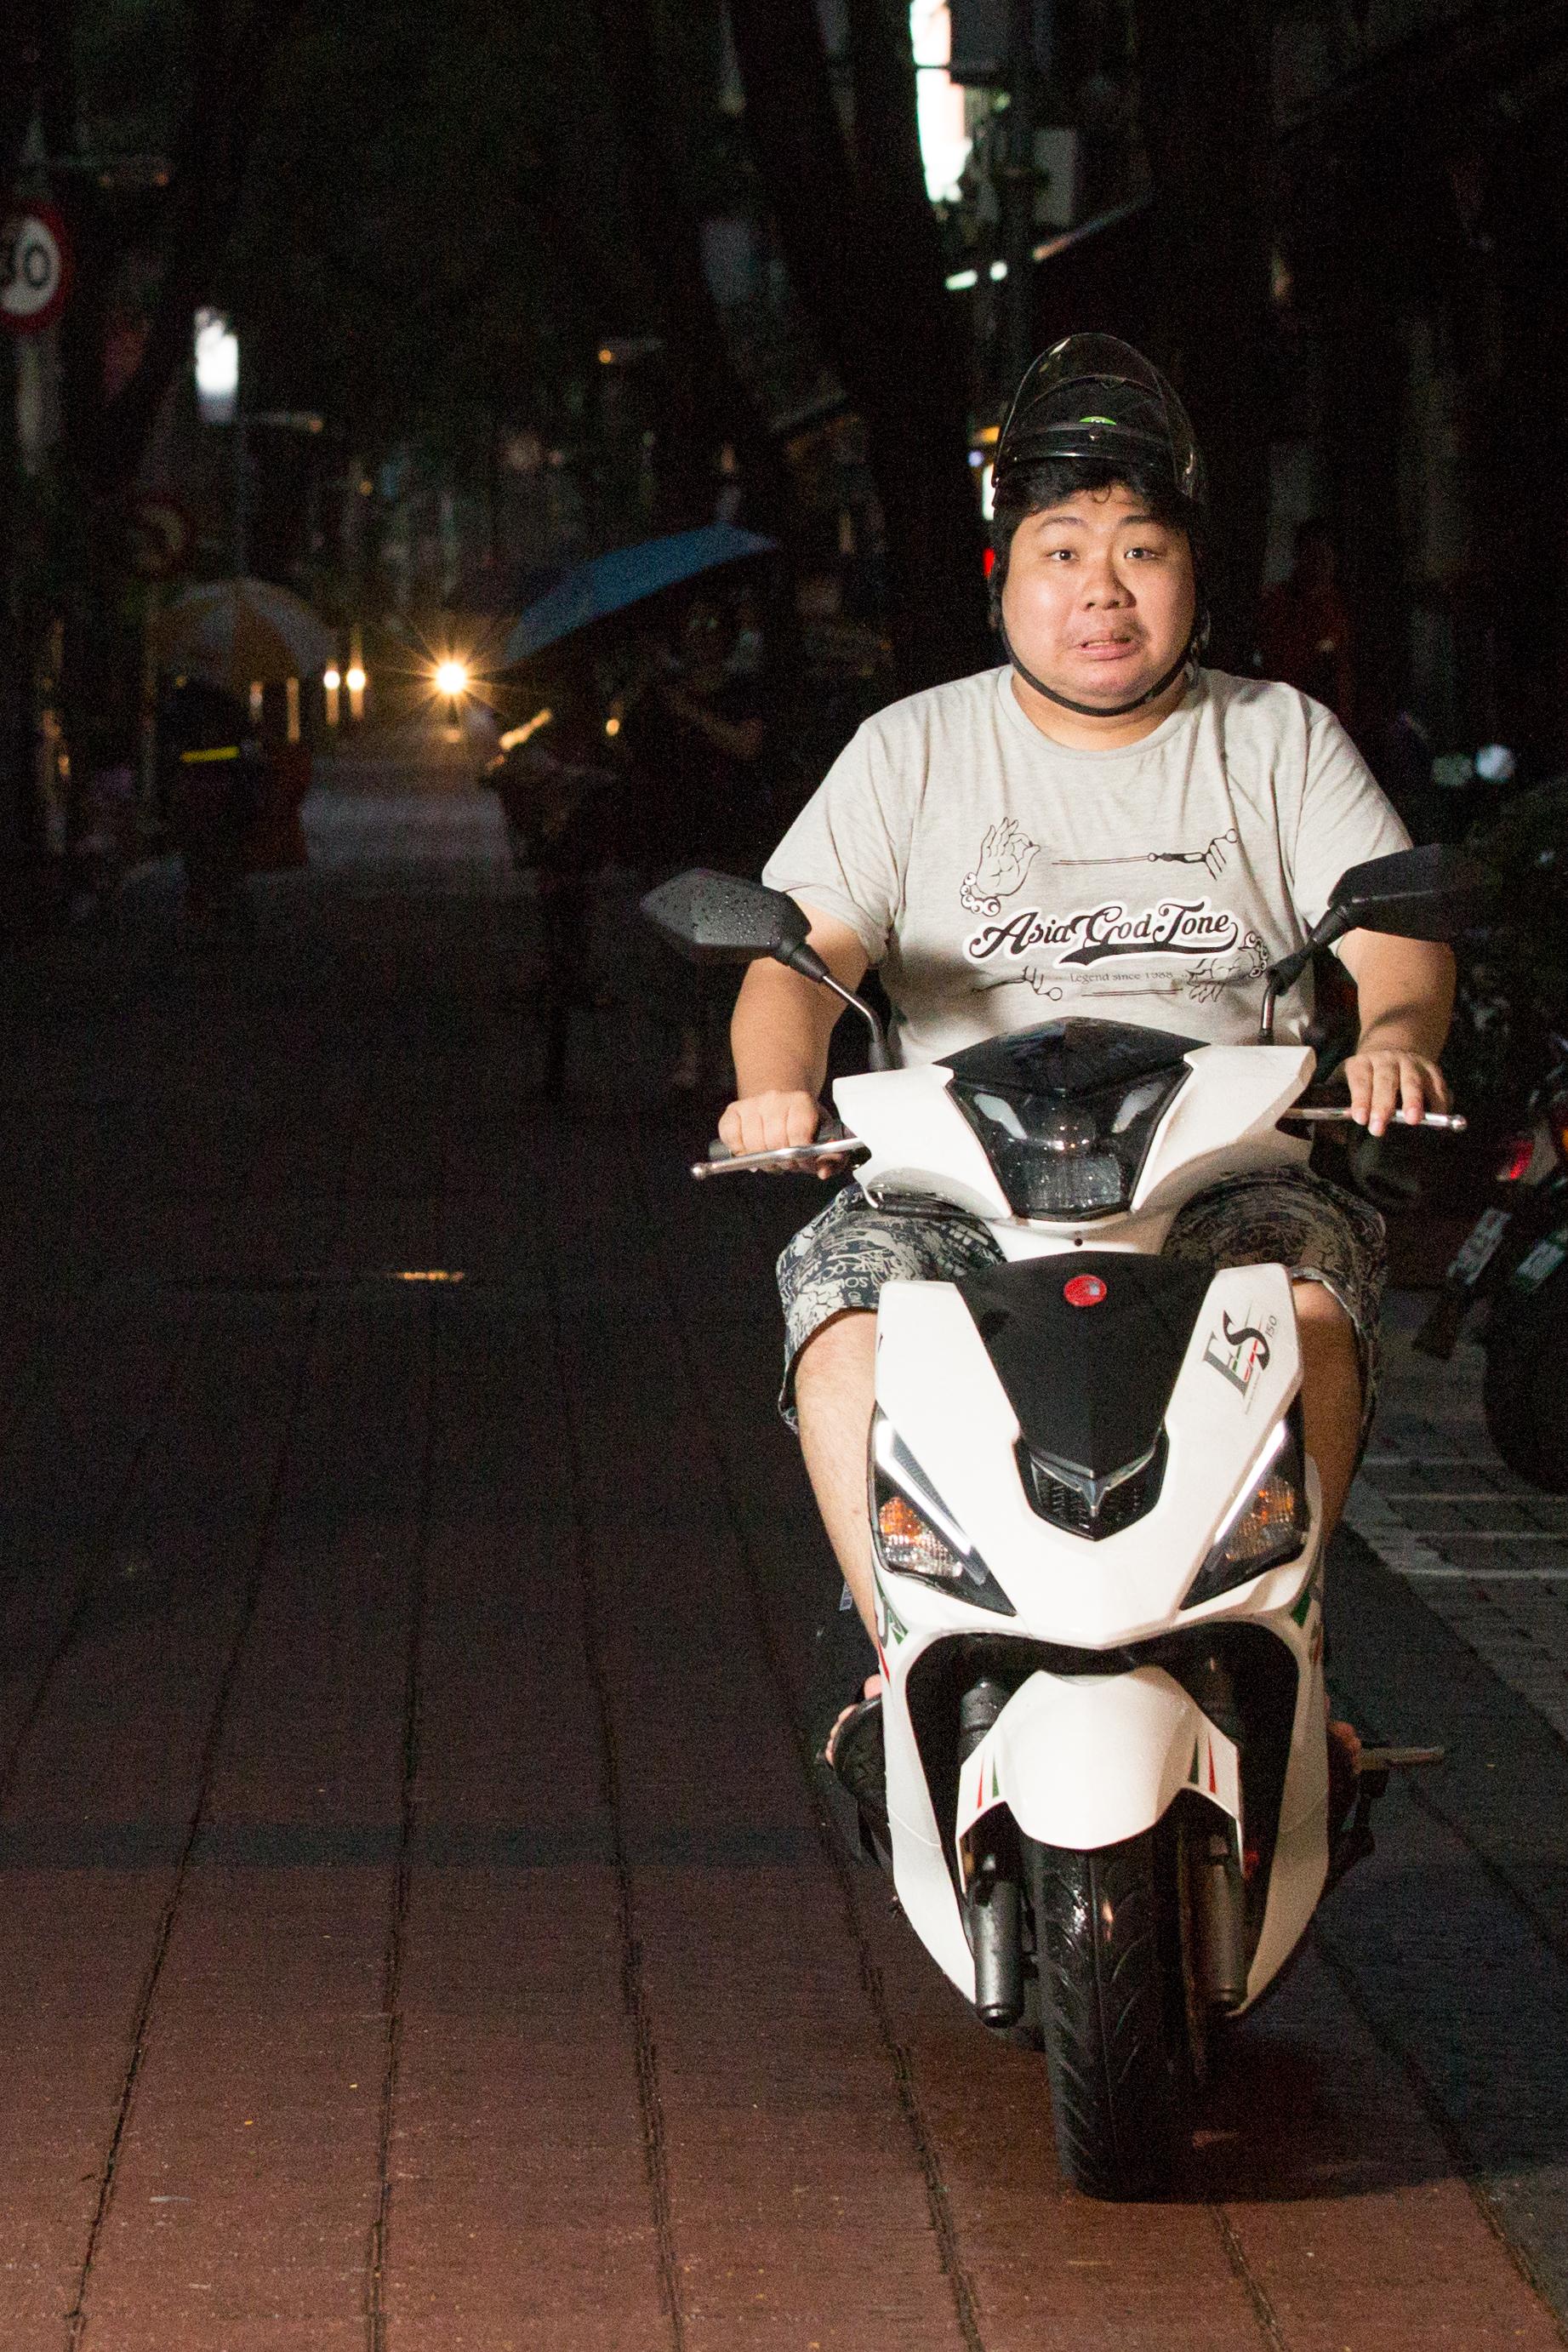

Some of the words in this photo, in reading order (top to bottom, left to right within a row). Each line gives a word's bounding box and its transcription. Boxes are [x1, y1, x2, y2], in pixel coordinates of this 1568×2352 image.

[969, 911, 1071, 958] Asia
[1070, 905, 1152, 946] God
[1153, 900, 1232, 944] Tone
[1069, 972, 1109, 985] Legend
[1112, 972, 1141, 980] since
[1202, 1310, 1270, 1400] ES
